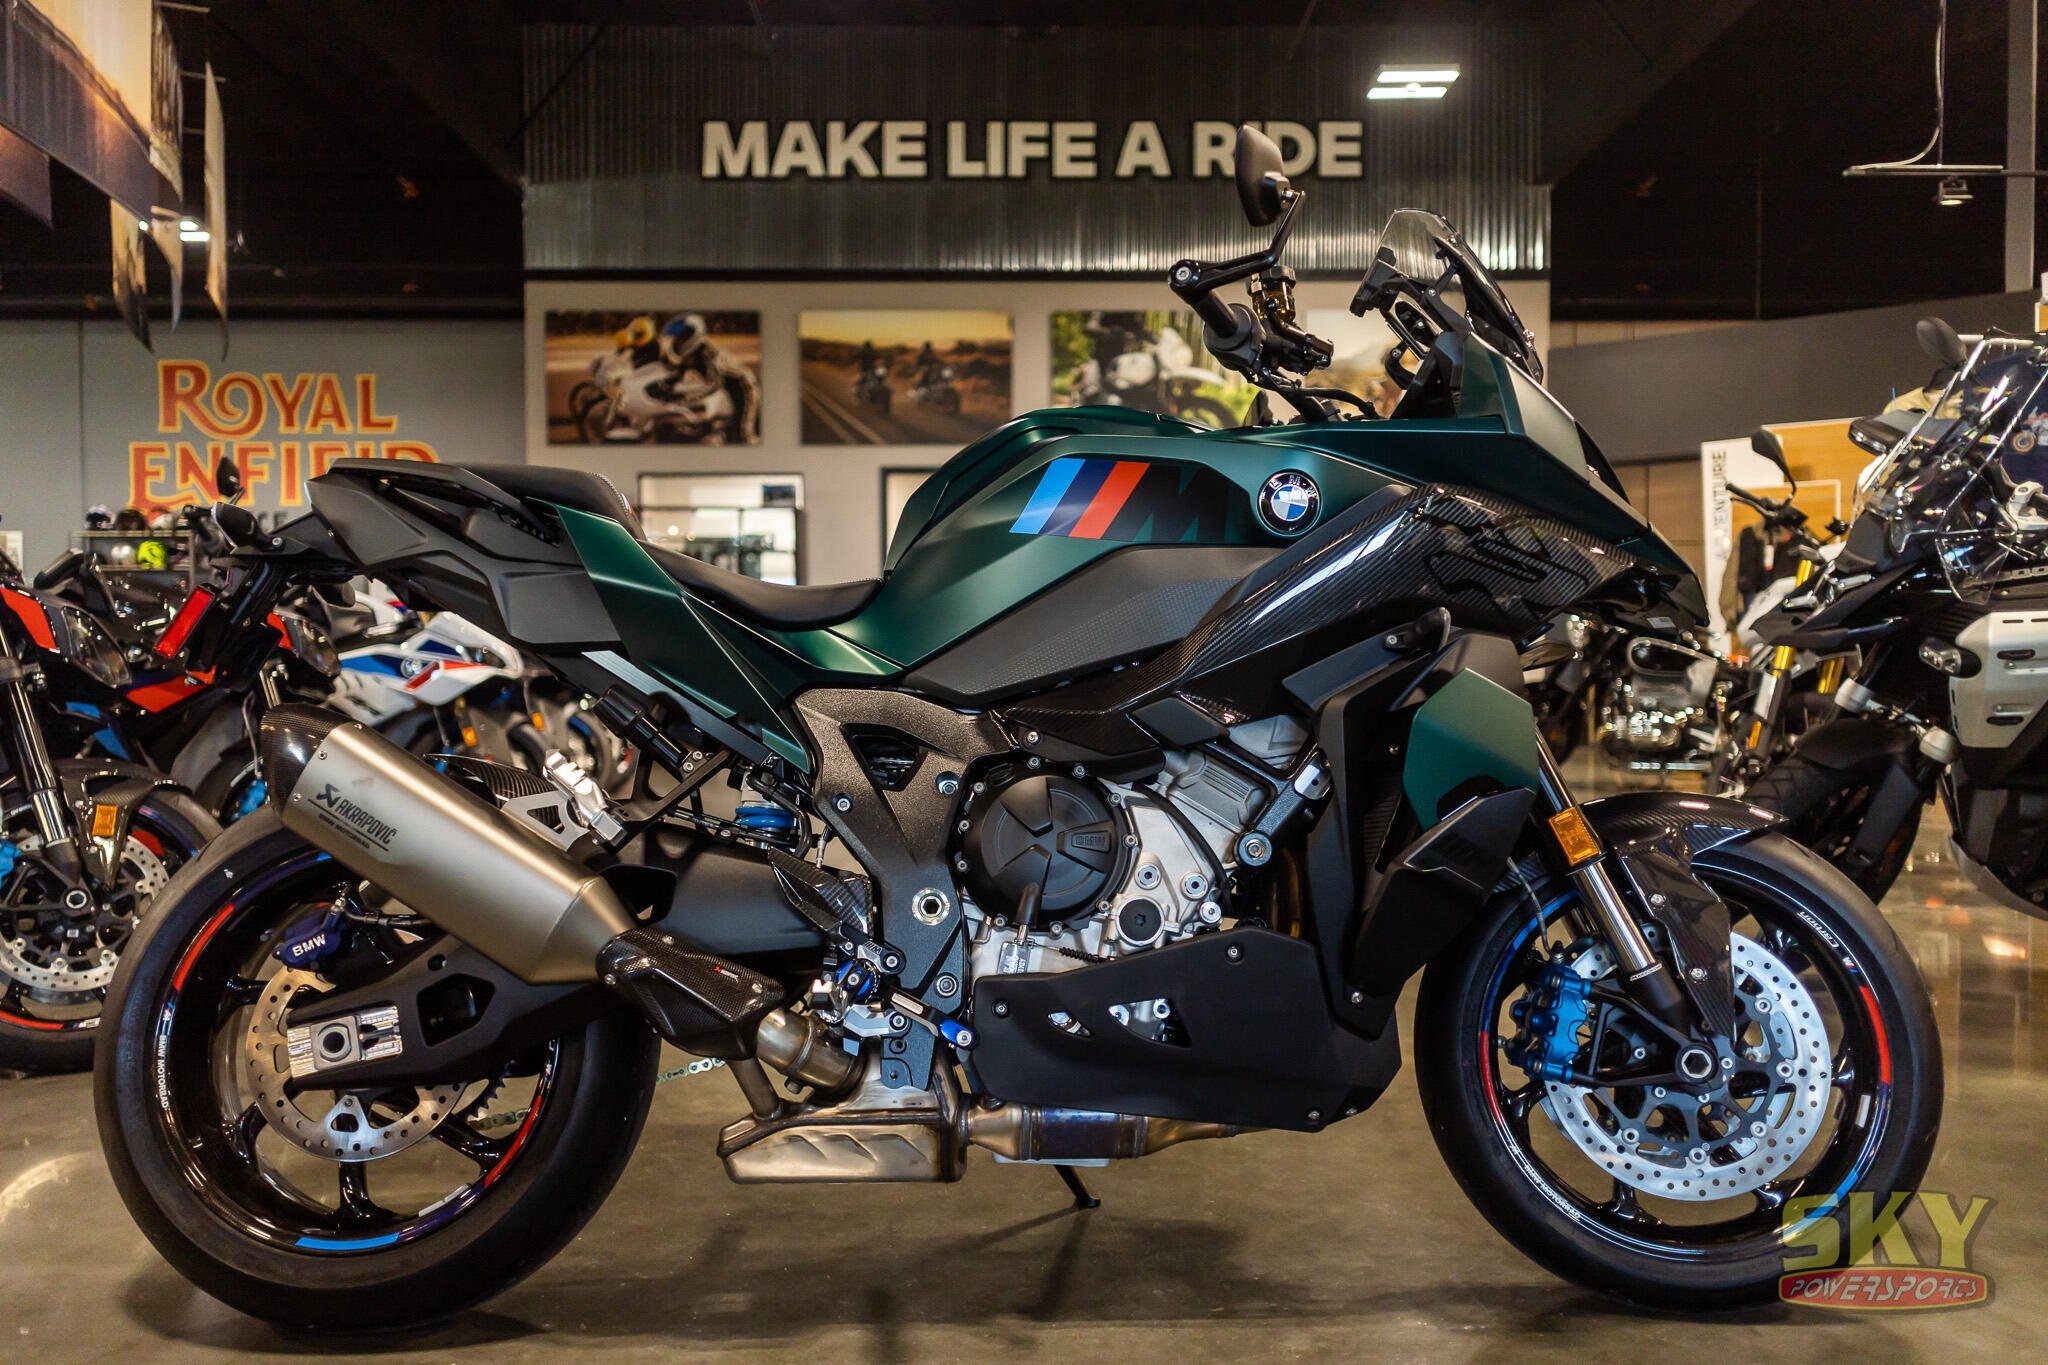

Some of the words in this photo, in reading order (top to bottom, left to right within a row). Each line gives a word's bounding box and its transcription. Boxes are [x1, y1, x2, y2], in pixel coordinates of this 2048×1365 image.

[701, 121, 927, 177] MAKE
[947, 121, 1097, 177] LIFE
[1115, 121, 1171, 177] A
[1193, 121, 1363, 177] RDE
[127, 440, 440, 518] ENFI
[292, 934, 326, 957] BMW
[157, 1034, 168, 1058] BMW
[157, 1059, 169, 1109] MOTORRAD
